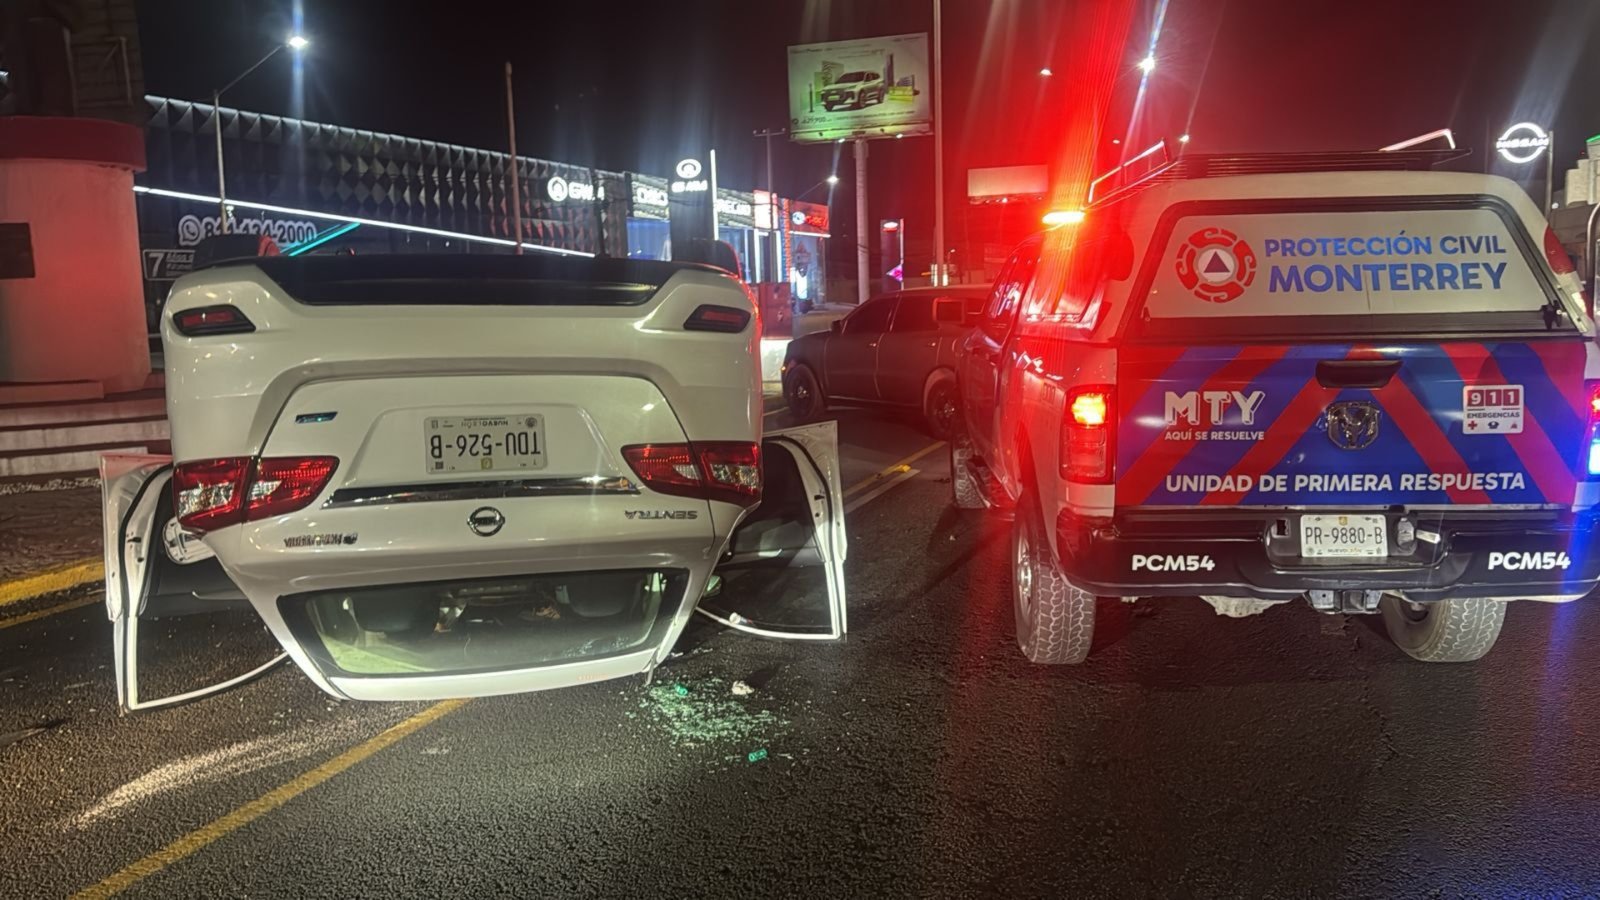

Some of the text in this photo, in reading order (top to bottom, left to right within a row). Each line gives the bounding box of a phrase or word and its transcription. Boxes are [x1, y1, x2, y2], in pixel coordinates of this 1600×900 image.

[1264, 230, 1507, 258] PROTECCIÓN CIVIL
[149, 252, 165, 278] 7
[1268, 262, 1508, 293] MONTERREY
[1164, 391, 1266, 425] MTY
[1466, 411, 1521, 419] EMERGENCIAS
[1165, 429, 1265, 440] AQUÍ SE RESUELVE
[430, 431, 541, 459] TDU-526-B
[1166, 472, 1525, 492] UNIDAD DE PRIMERA RESPUESTA
[625, 509, 698, 520] SENTRA
[1305, 526, 1383, 545] PR-9880-B
[1131, 554, 1216, 572] PCM54
[1487, 551, 1571, 570] PCM54
